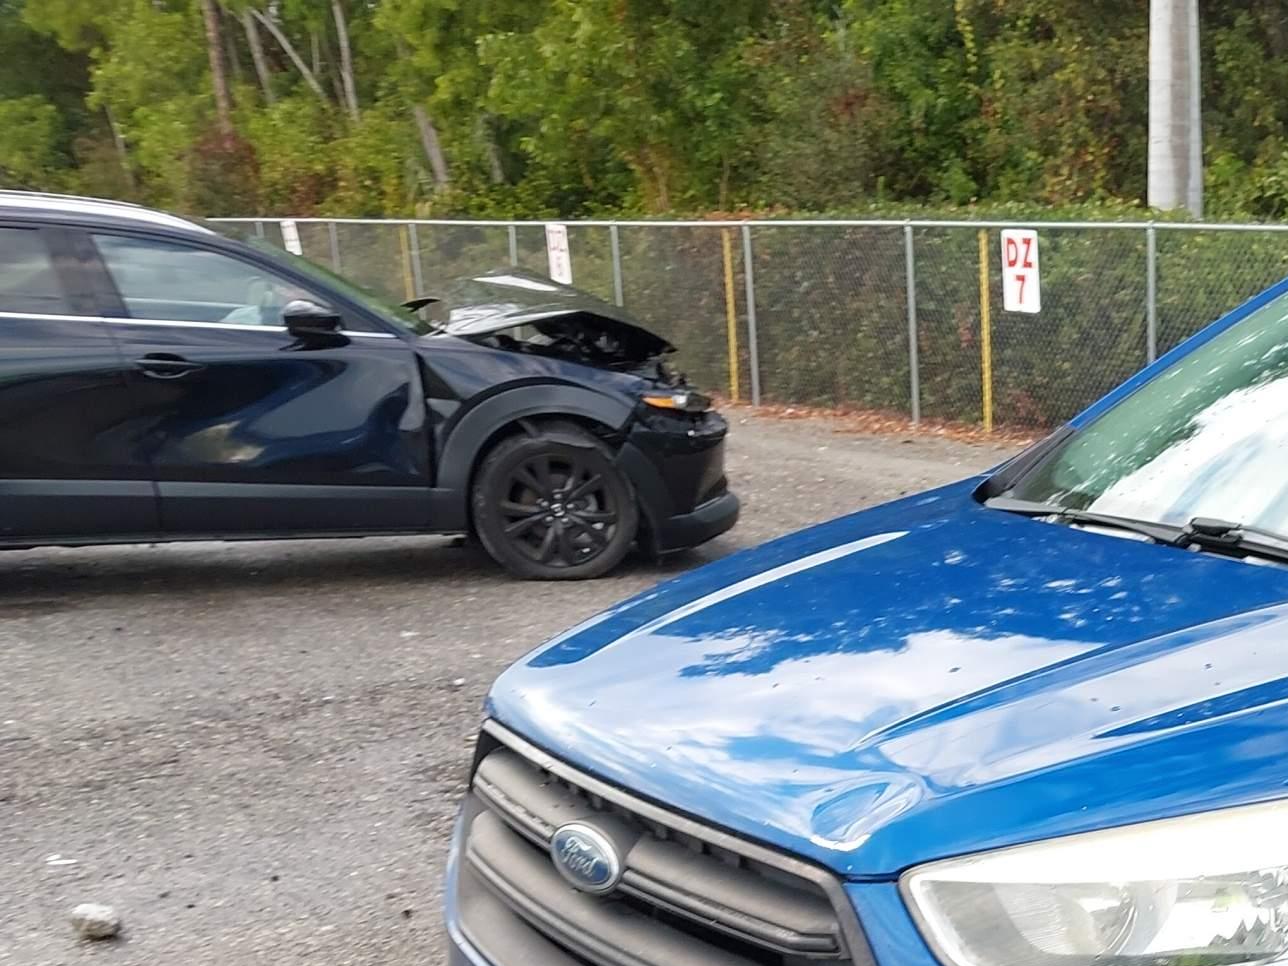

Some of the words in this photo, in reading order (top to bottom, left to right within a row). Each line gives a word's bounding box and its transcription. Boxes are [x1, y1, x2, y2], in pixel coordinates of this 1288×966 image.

[1006, 237, 1033, 268] DZ
[1015, 274, 1026, 305] 7
[561, 836, 603, 878] Ford
